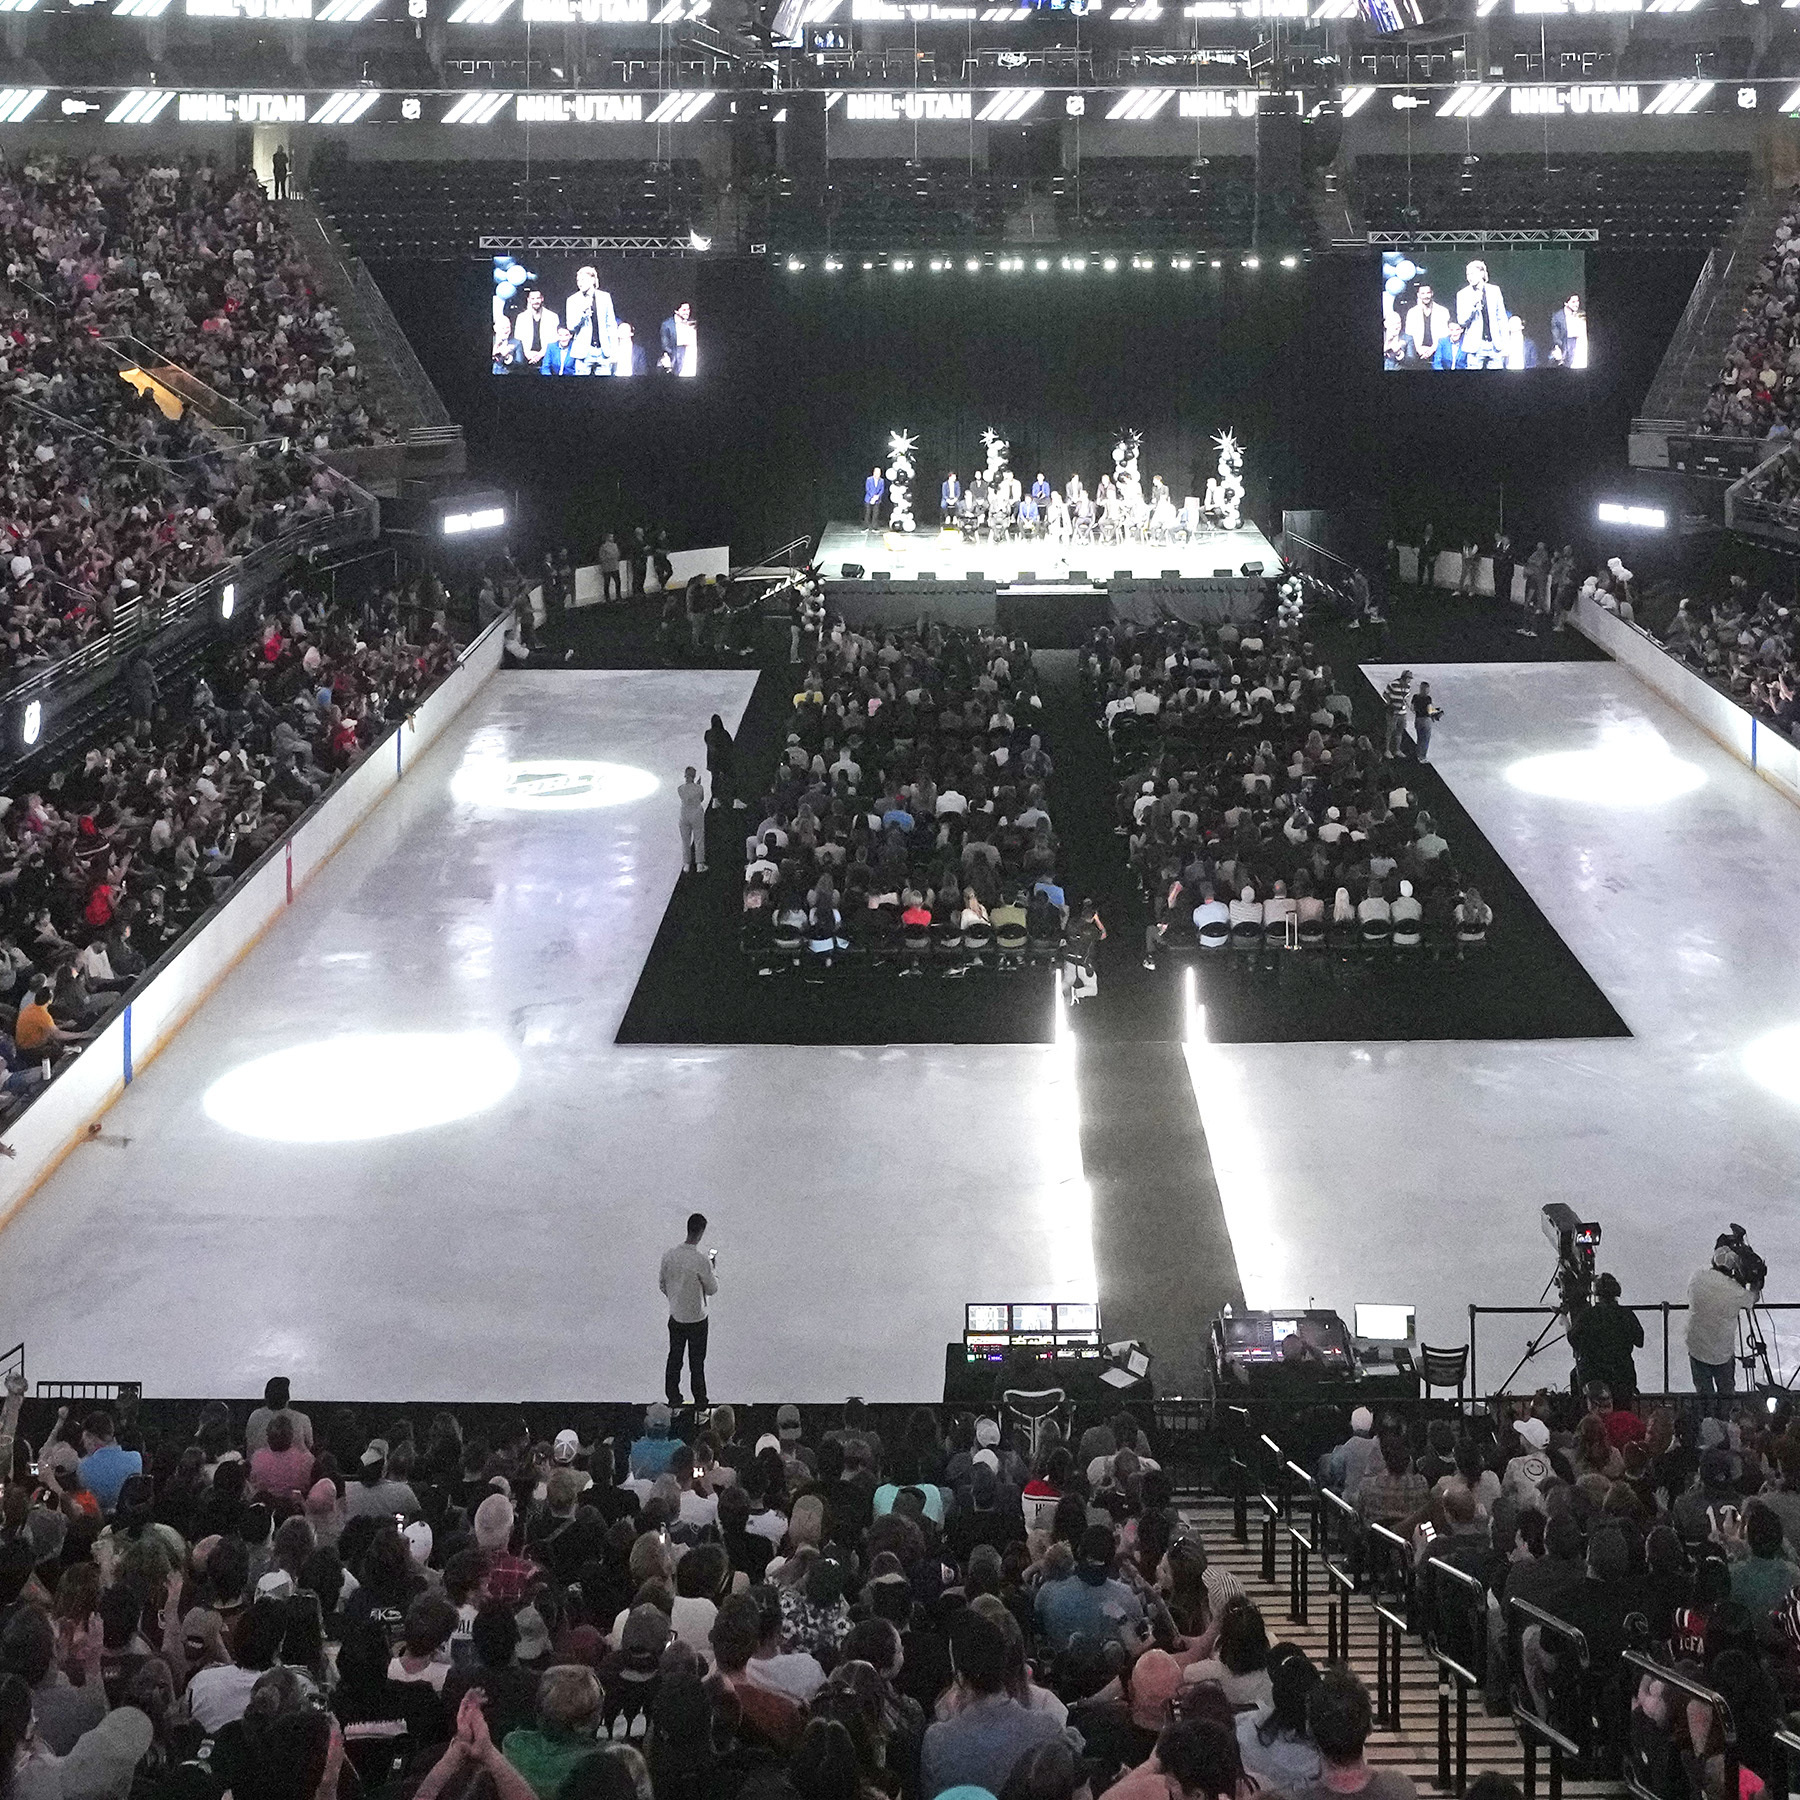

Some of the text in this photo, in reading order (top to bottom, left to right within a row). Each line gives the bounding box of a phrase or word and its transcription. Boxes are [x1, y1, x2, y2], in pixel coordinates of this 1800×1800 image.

[238, 94, 305, 121] UTAH
[517, 96, 570, 121] NHL
[575, 96, 642, 121] UTAH
[847, 93, 899, 119] NHL
[905, 93, 971, 119] UTAH
[1180, 91, 1231, 117] NHL
[1511, 87, 1565, 113] NHL
[1570, 86, 1639, 112] UTAH
